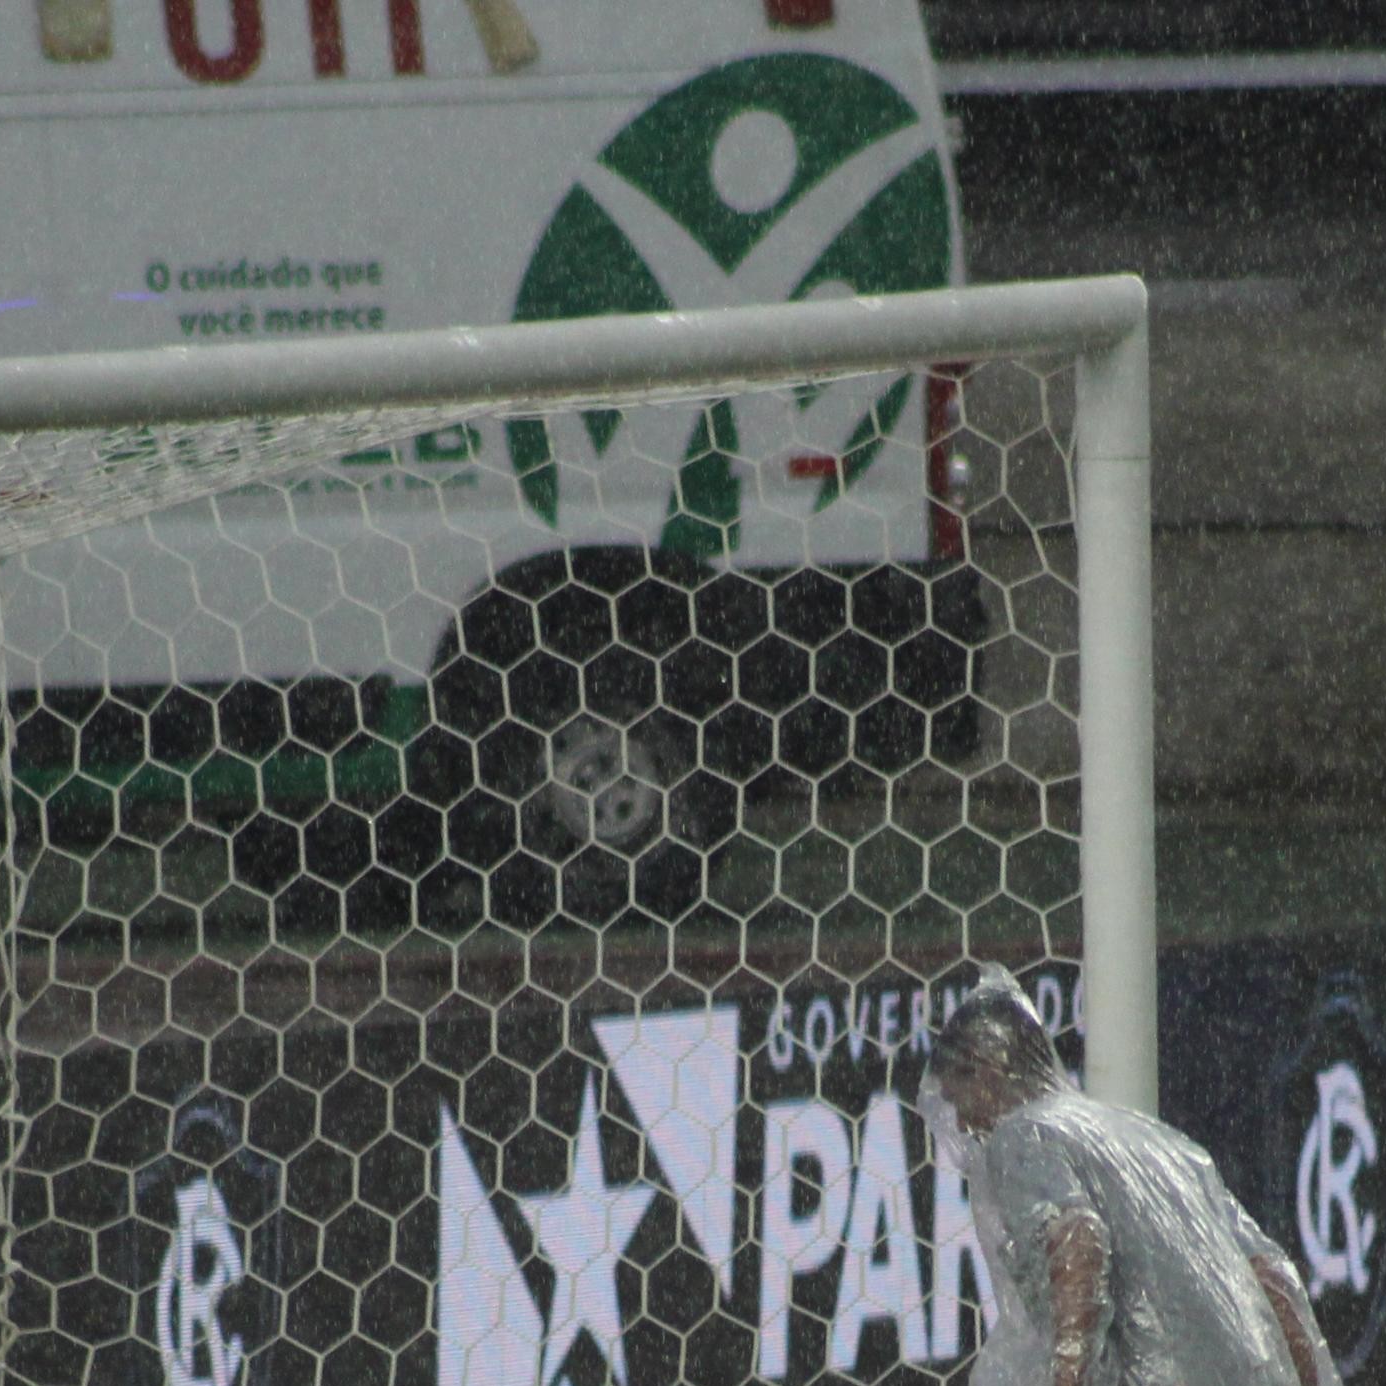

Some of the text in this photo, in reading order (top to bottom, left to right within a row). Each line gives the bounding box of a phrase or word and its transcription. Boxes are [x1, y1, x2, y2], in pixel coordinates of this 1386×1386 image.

[146, 257, 382, 293] O cuidado que
[262, 305, 385, 333] merece
